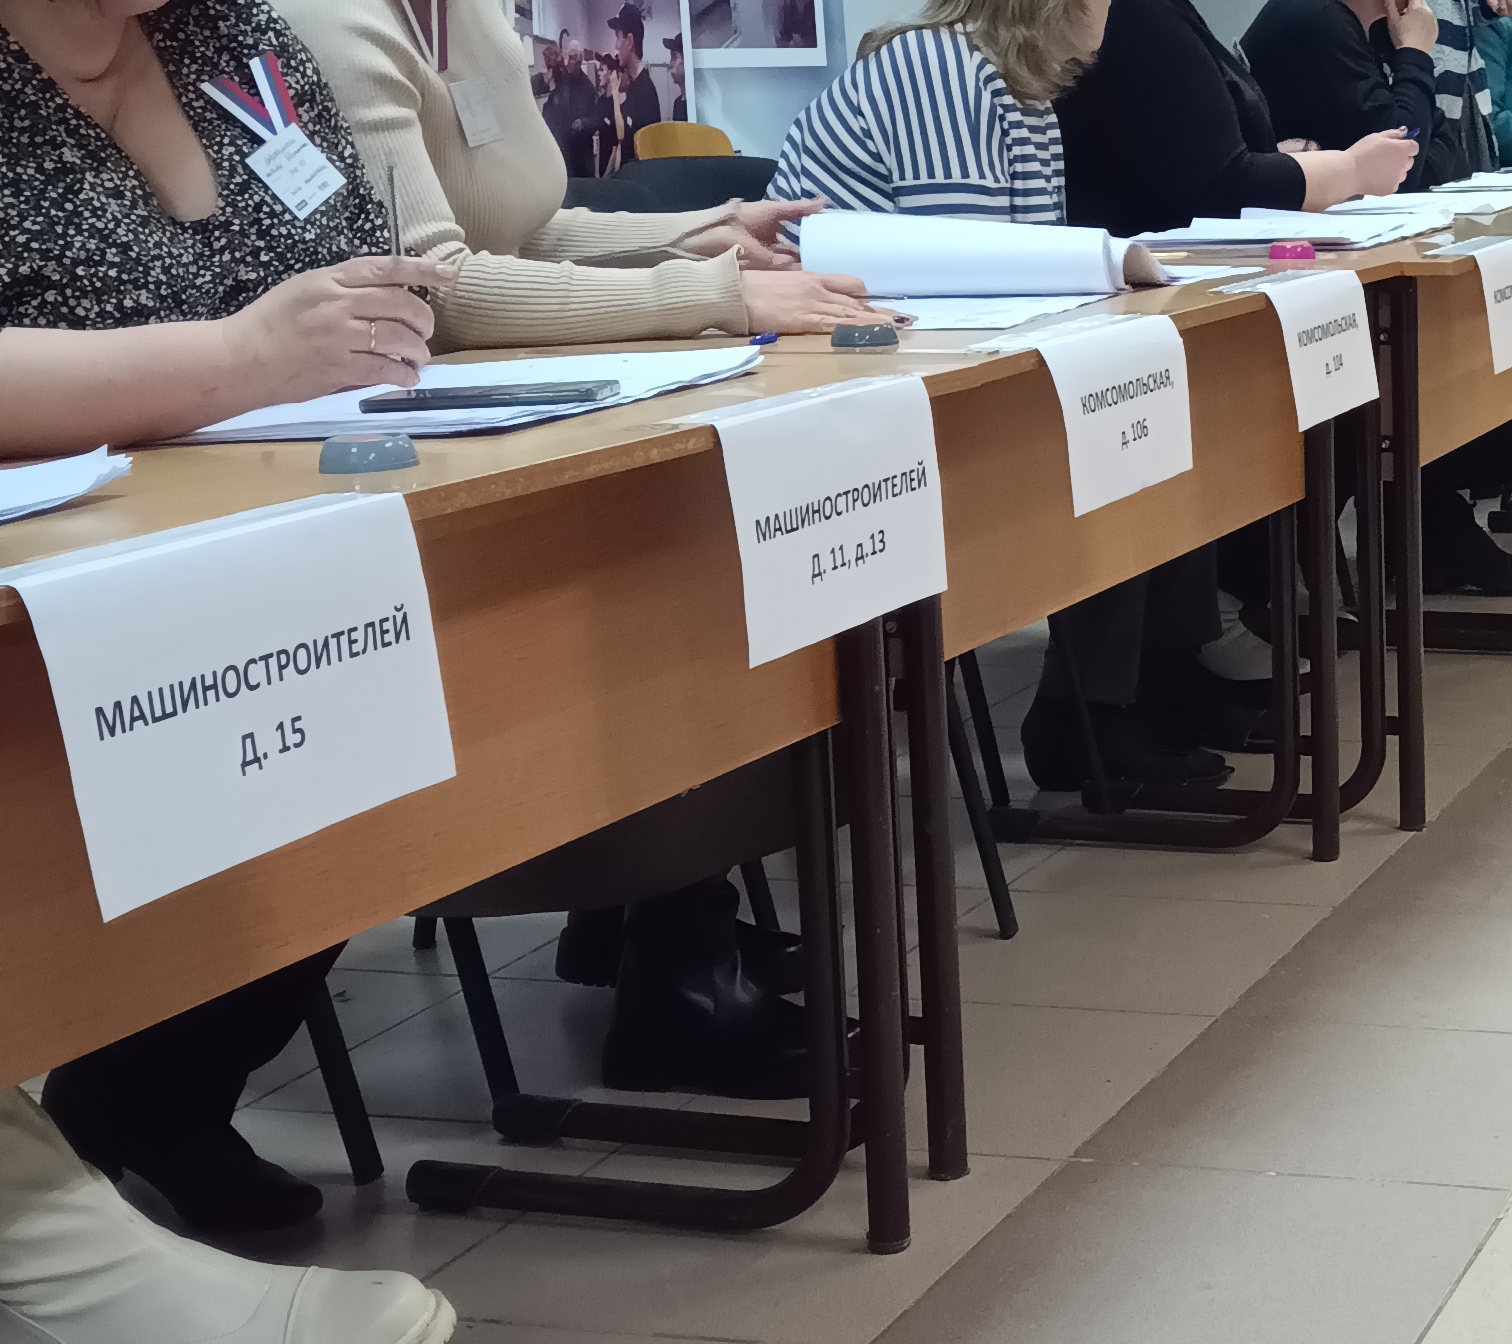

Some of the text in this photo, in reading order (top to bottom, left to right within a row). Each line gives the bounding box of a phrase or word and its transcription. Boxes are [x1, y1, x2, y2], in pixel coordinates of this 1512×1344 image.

[1080, 368, 1175, 416] КОМСОМОЛЬСКАЯ,
[1121, 418, 1149, 451] д. 106
[755, 460, 928, 544] МАШИНОСТРОИТЕЛЕЙ
[830, 544, 852, 570] 11,
[94, 603, 411, 741] МАШИНОСТРОИТЕЛЕЙ
[275, 715, 306, 754] 15
